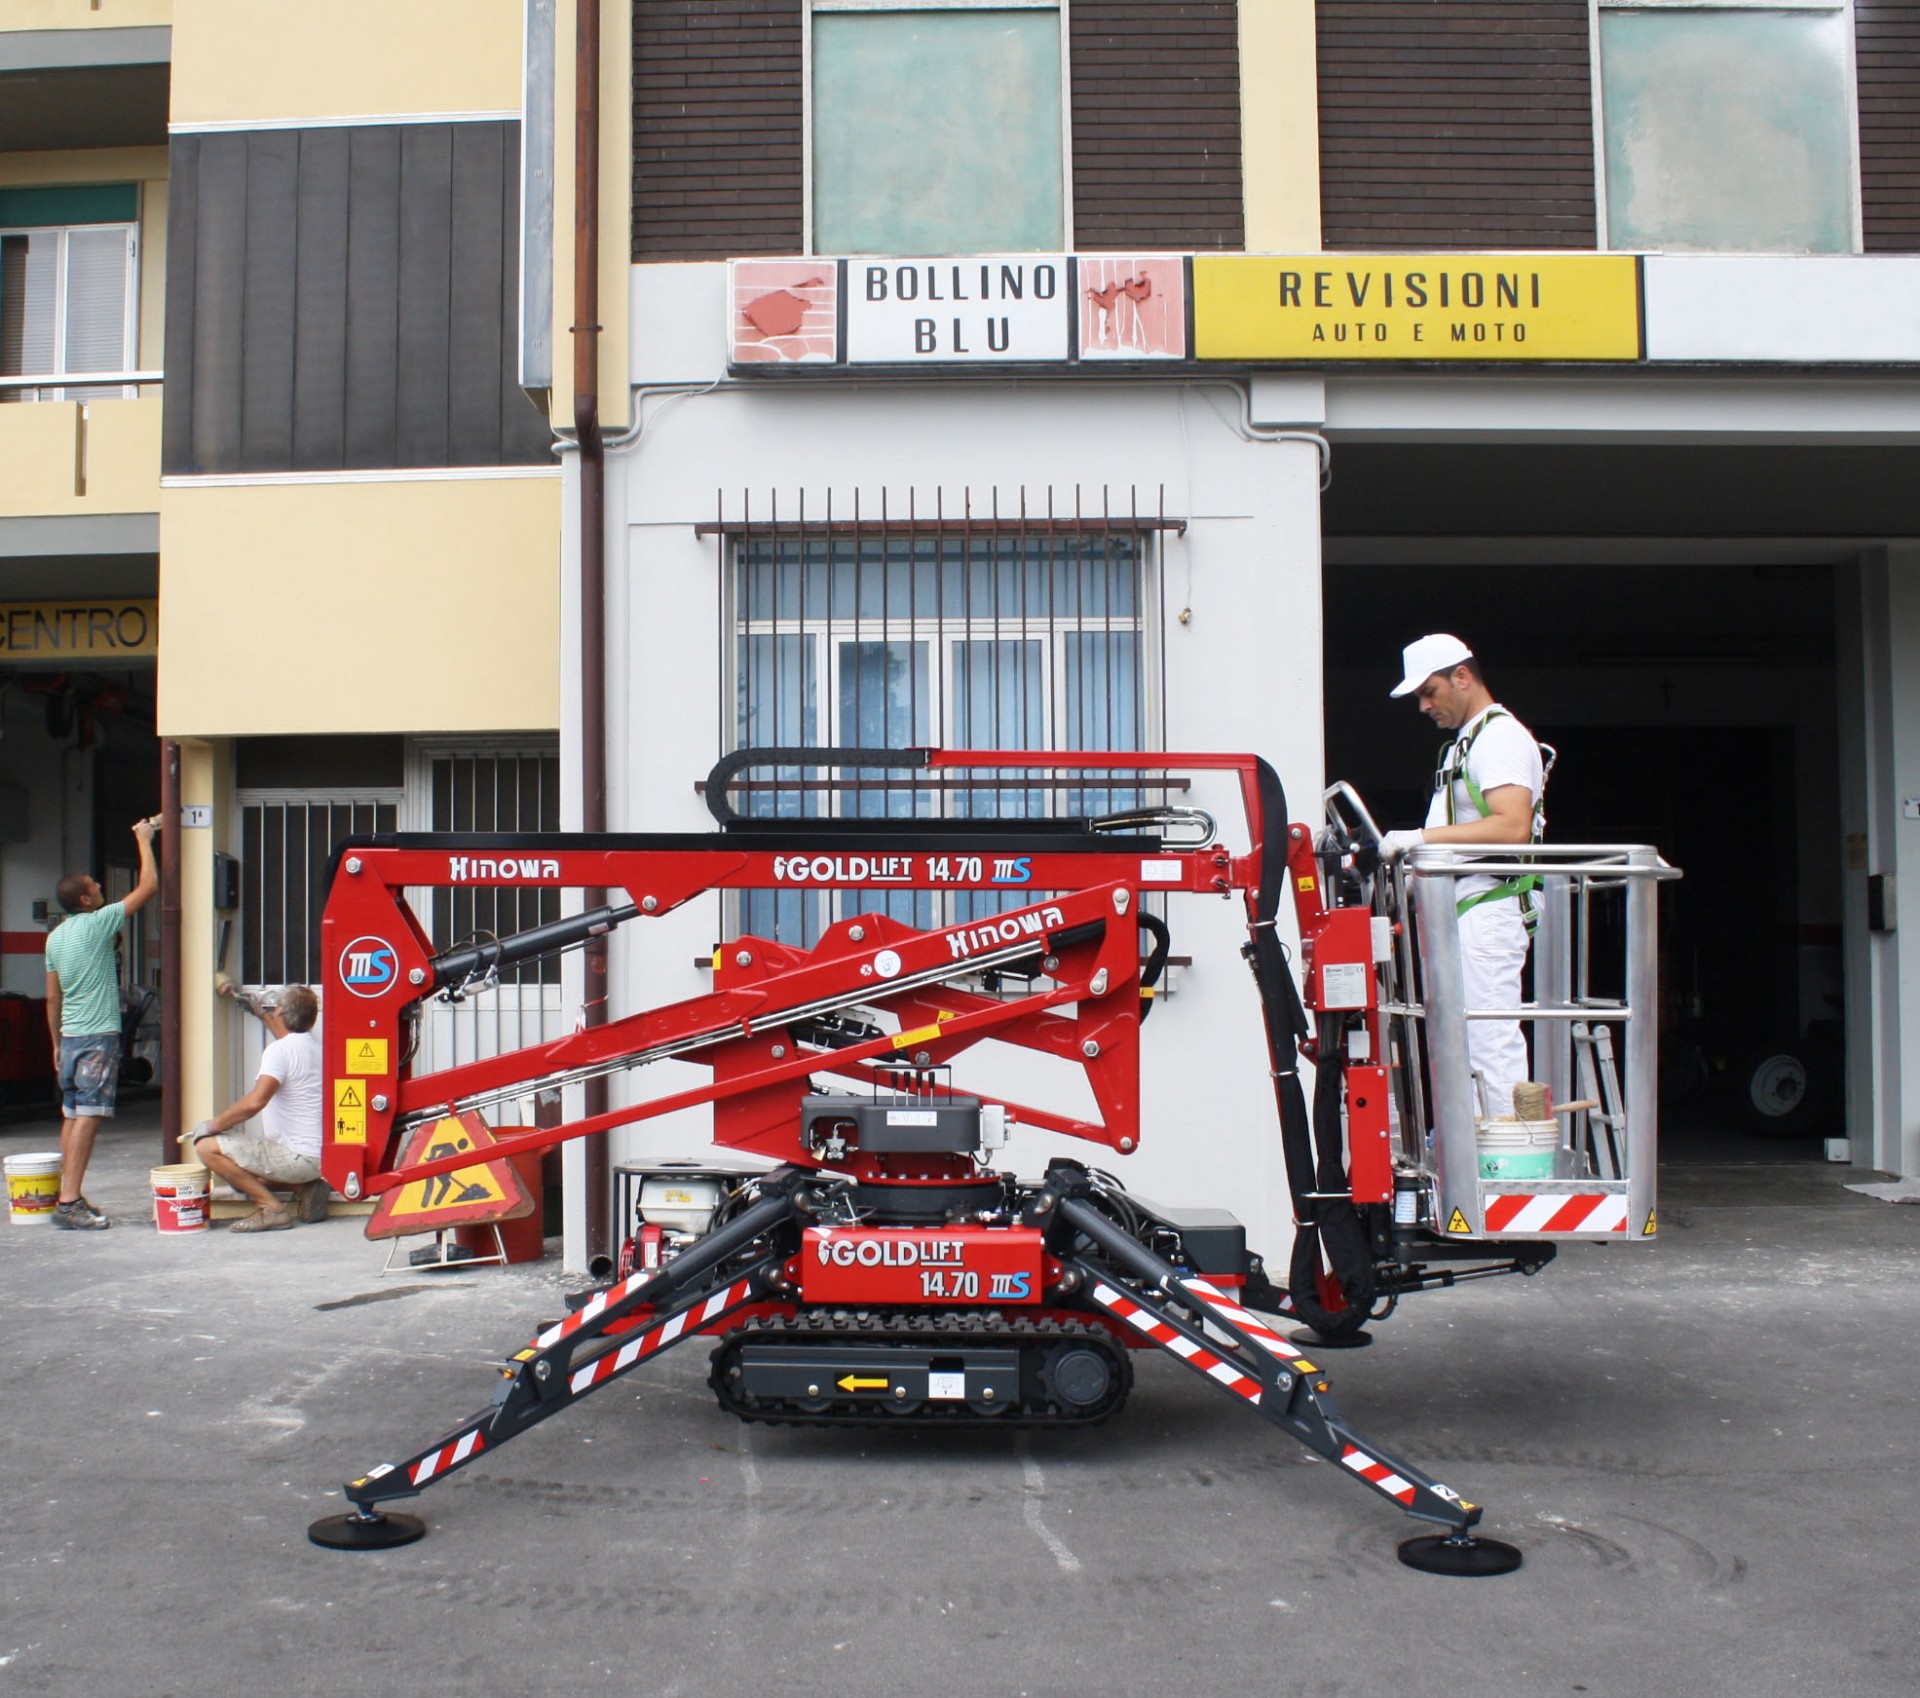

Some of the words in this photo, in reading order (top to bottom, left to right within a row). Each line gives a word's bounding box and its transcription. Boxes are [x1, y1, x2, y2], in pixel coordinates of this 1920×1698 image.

[865, 264, 1056, 301] BOLLINO
[1279, 271, 1542, 309] REVISIONI
[914, 316, 1010, 353] BLU
[1312, 323, 1388, 343] AUTO
[1414, 323, 1424, 343] E
[1451, 323, 1527, 343] MOTO
[0, 607, 148, 650] ENTRO
[925, 857, 982, 882] 14.70
[920, 1271, 979, 1298] 14.70
